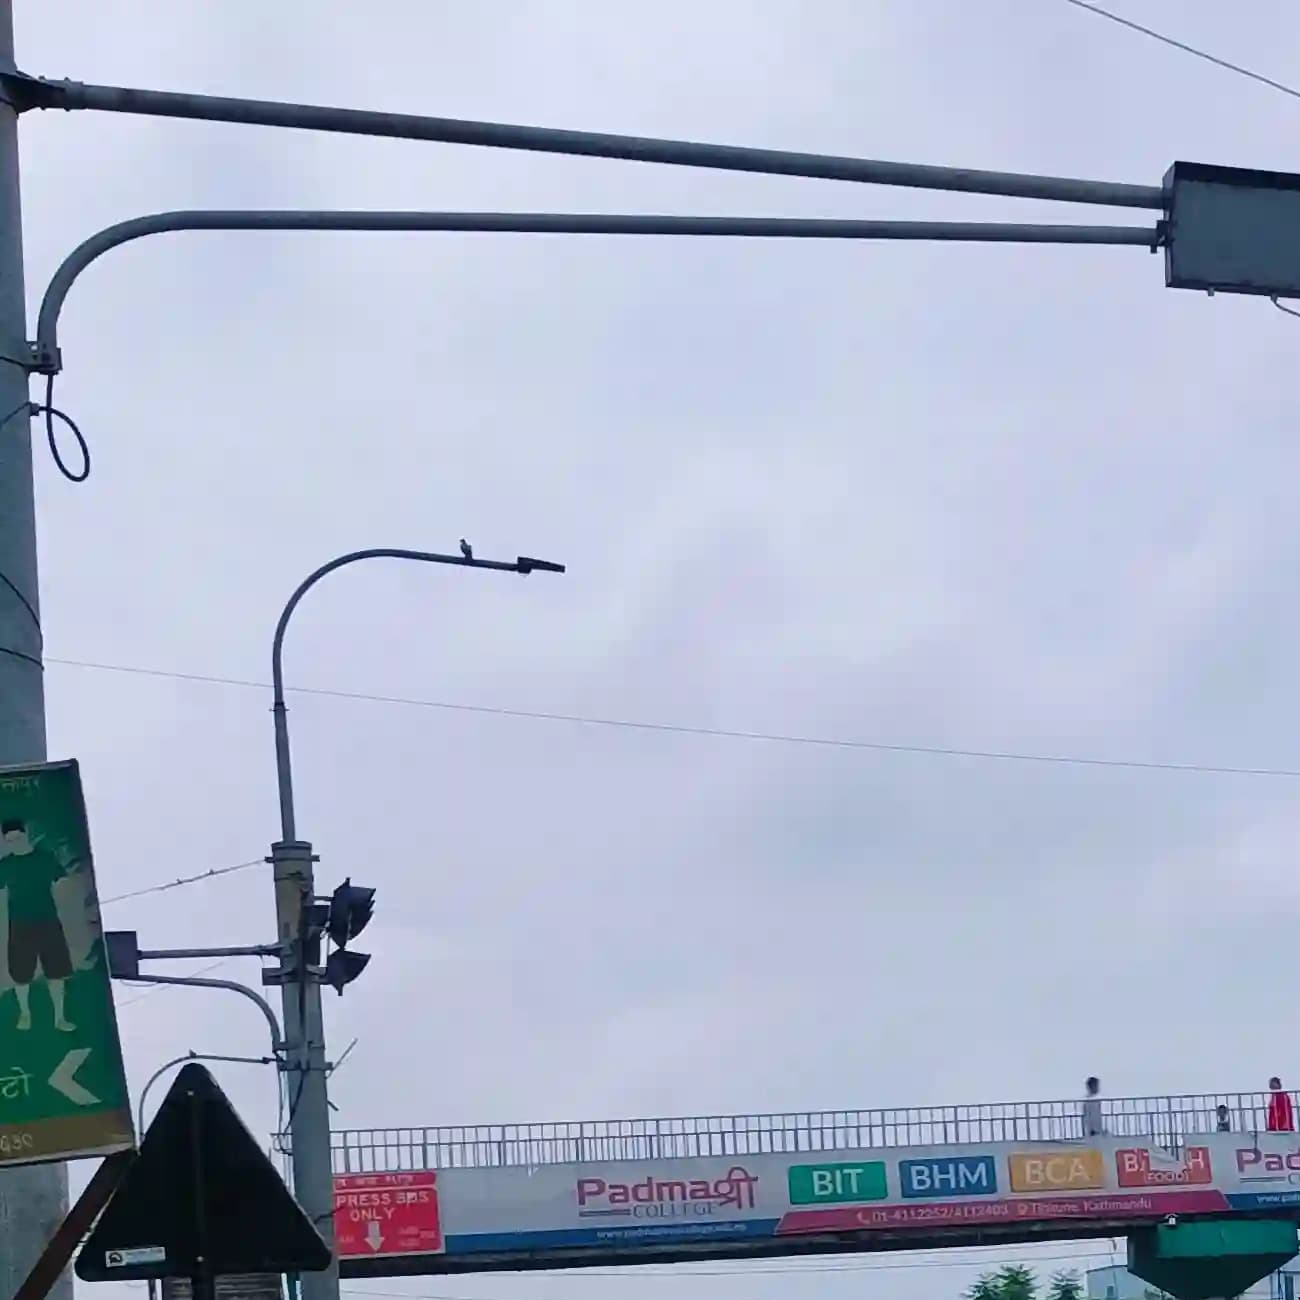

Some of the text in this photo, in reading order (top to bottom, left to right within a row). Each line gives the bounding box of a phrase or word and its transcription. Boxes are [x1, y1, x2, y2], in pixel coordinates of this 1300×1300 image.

[812, 1168, 864, 1196] BIT
[910, 1162, 988, 1191] BHM
[1024, 1158, 1090, 1185] BCA
[350, 1207, 396, 1222] ONLY
